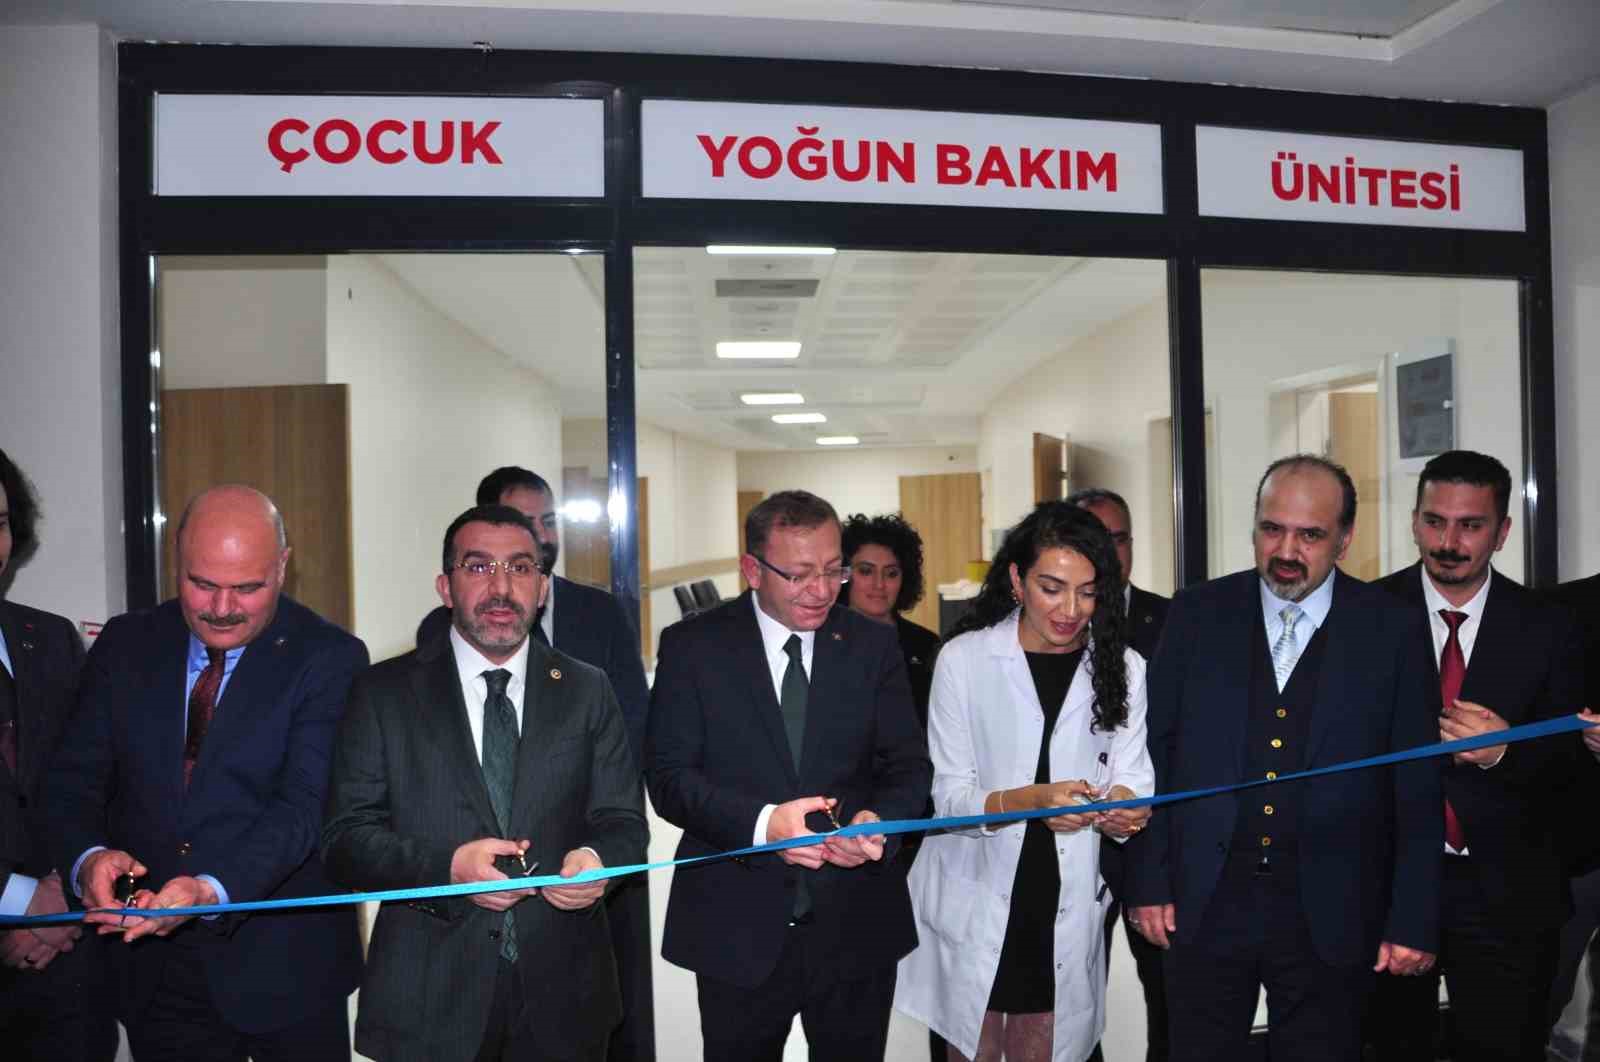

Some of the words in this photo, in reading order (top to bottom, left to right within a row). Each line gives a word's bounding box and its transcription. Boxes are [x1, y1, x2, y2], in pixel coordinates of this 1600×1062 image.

[267, 117, 502, 173] ÇOCUK
[697, 126, 917, 184] YOĞUN
[935, 143, 1118, 193] BAKIM
[1271, 151, 1461, 211] ÜNİTESİ
